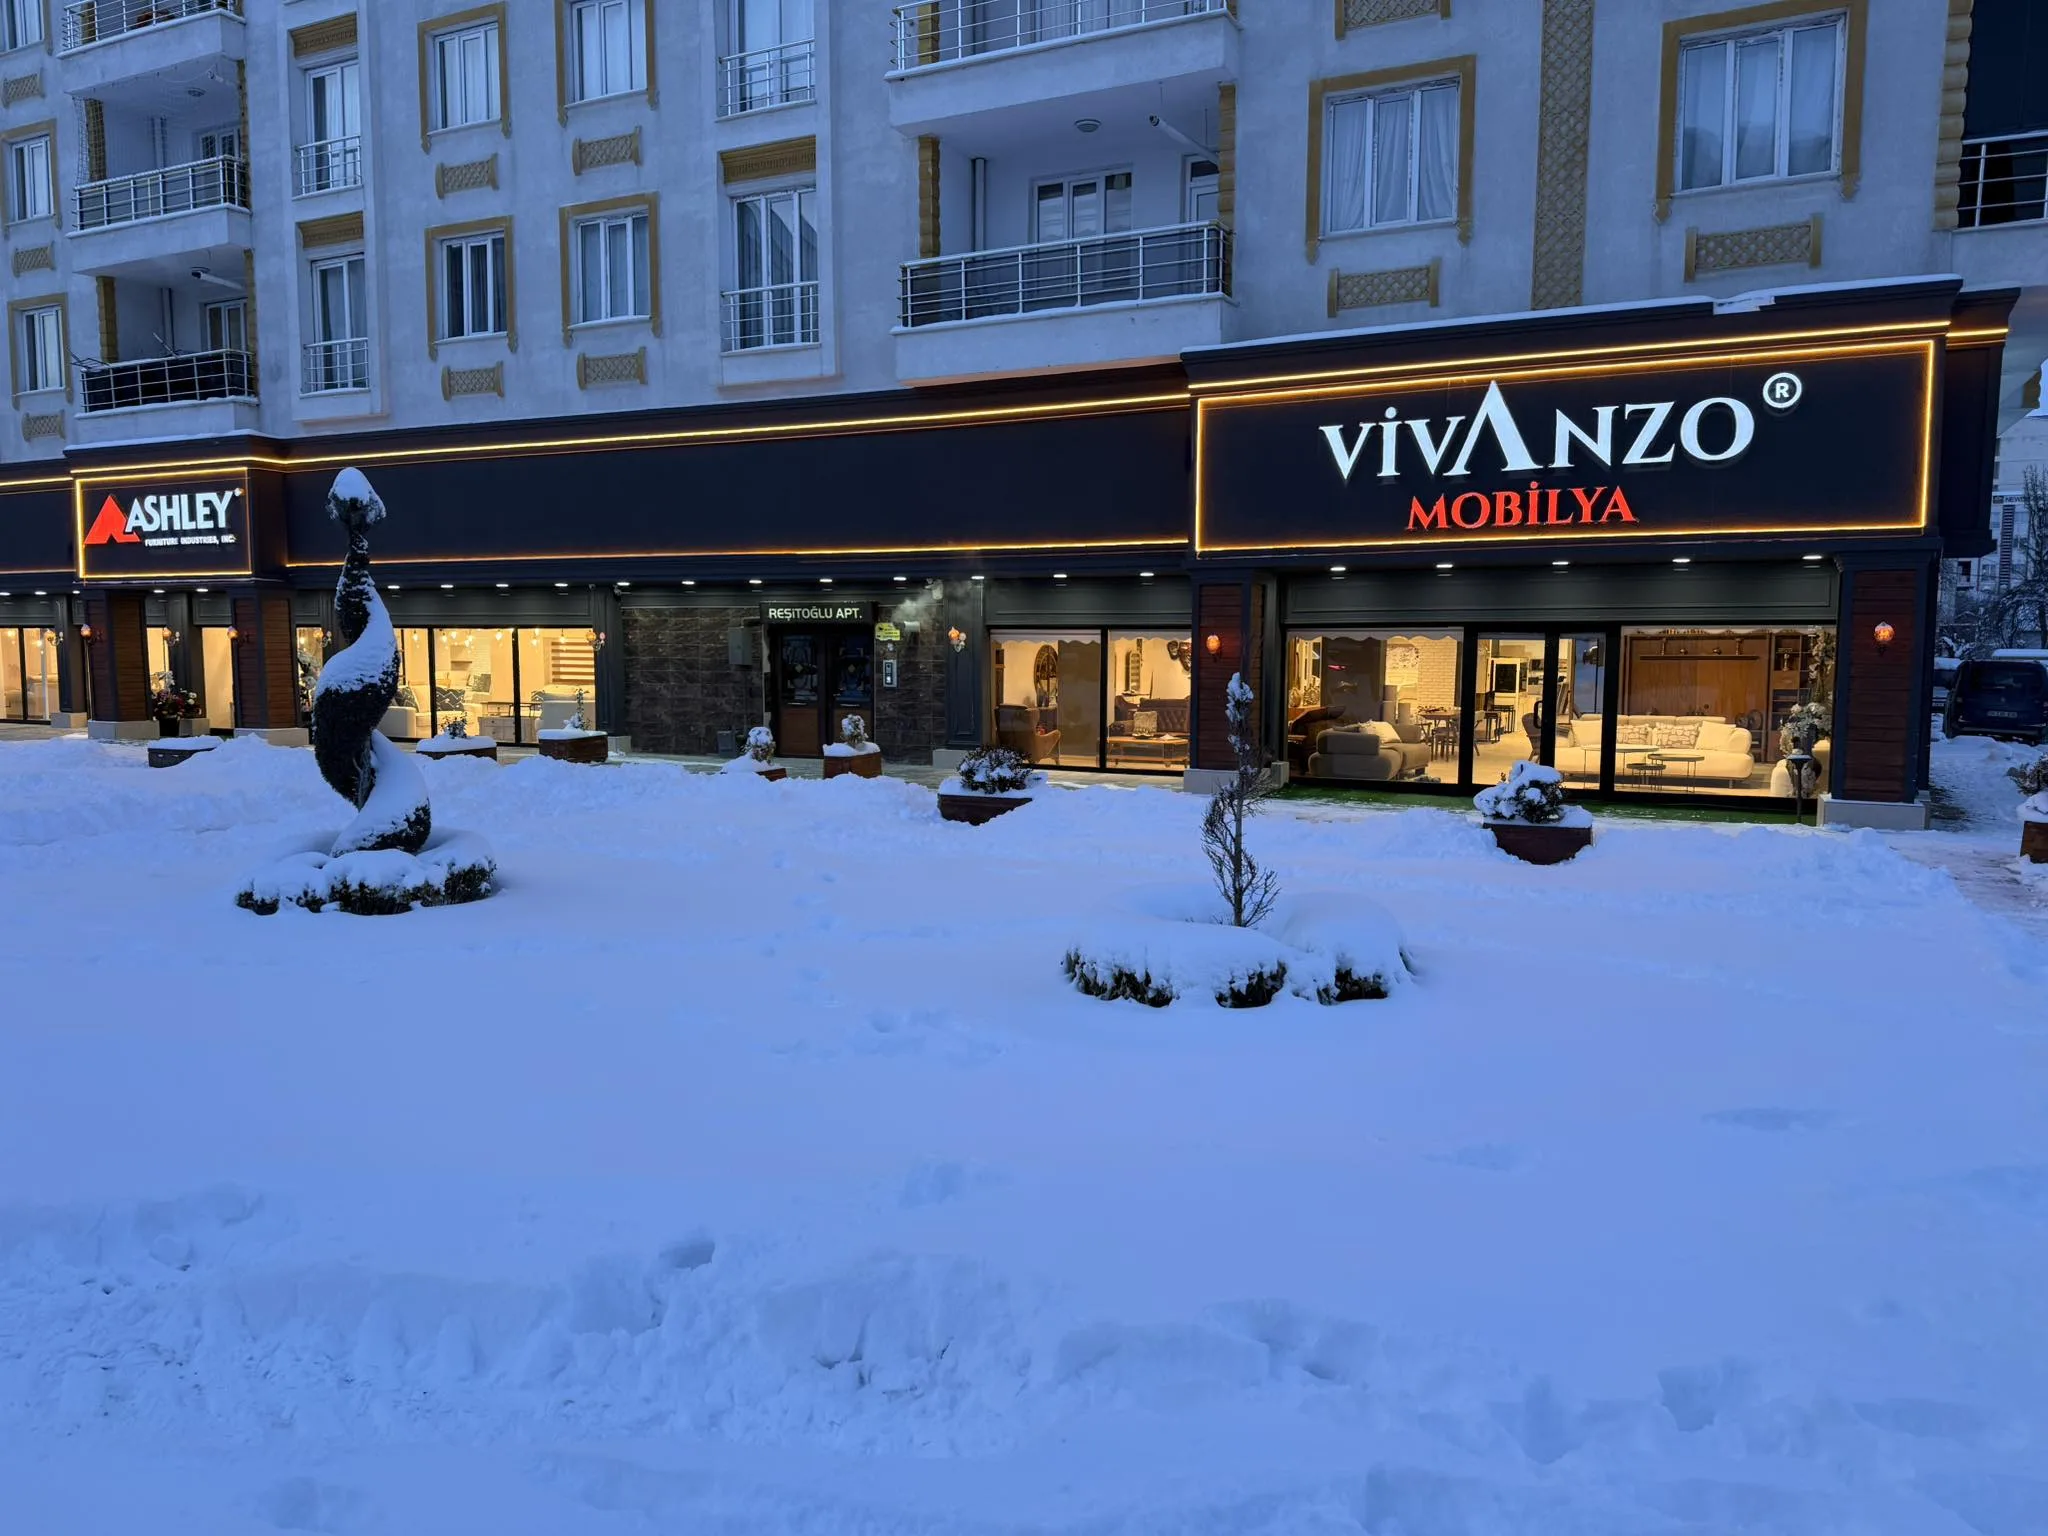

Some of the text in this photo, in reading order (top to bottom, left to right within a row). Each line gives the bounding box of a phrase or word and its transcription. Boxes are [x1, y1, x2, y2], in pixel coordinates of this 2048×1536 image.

[125, 491, 234, 532] ASHLEY
[1405, 480, 1640, 530] MOBİLYA
[145, 537, 179, 547] FURNITURE
[836, 607, 863, 619] APT.
